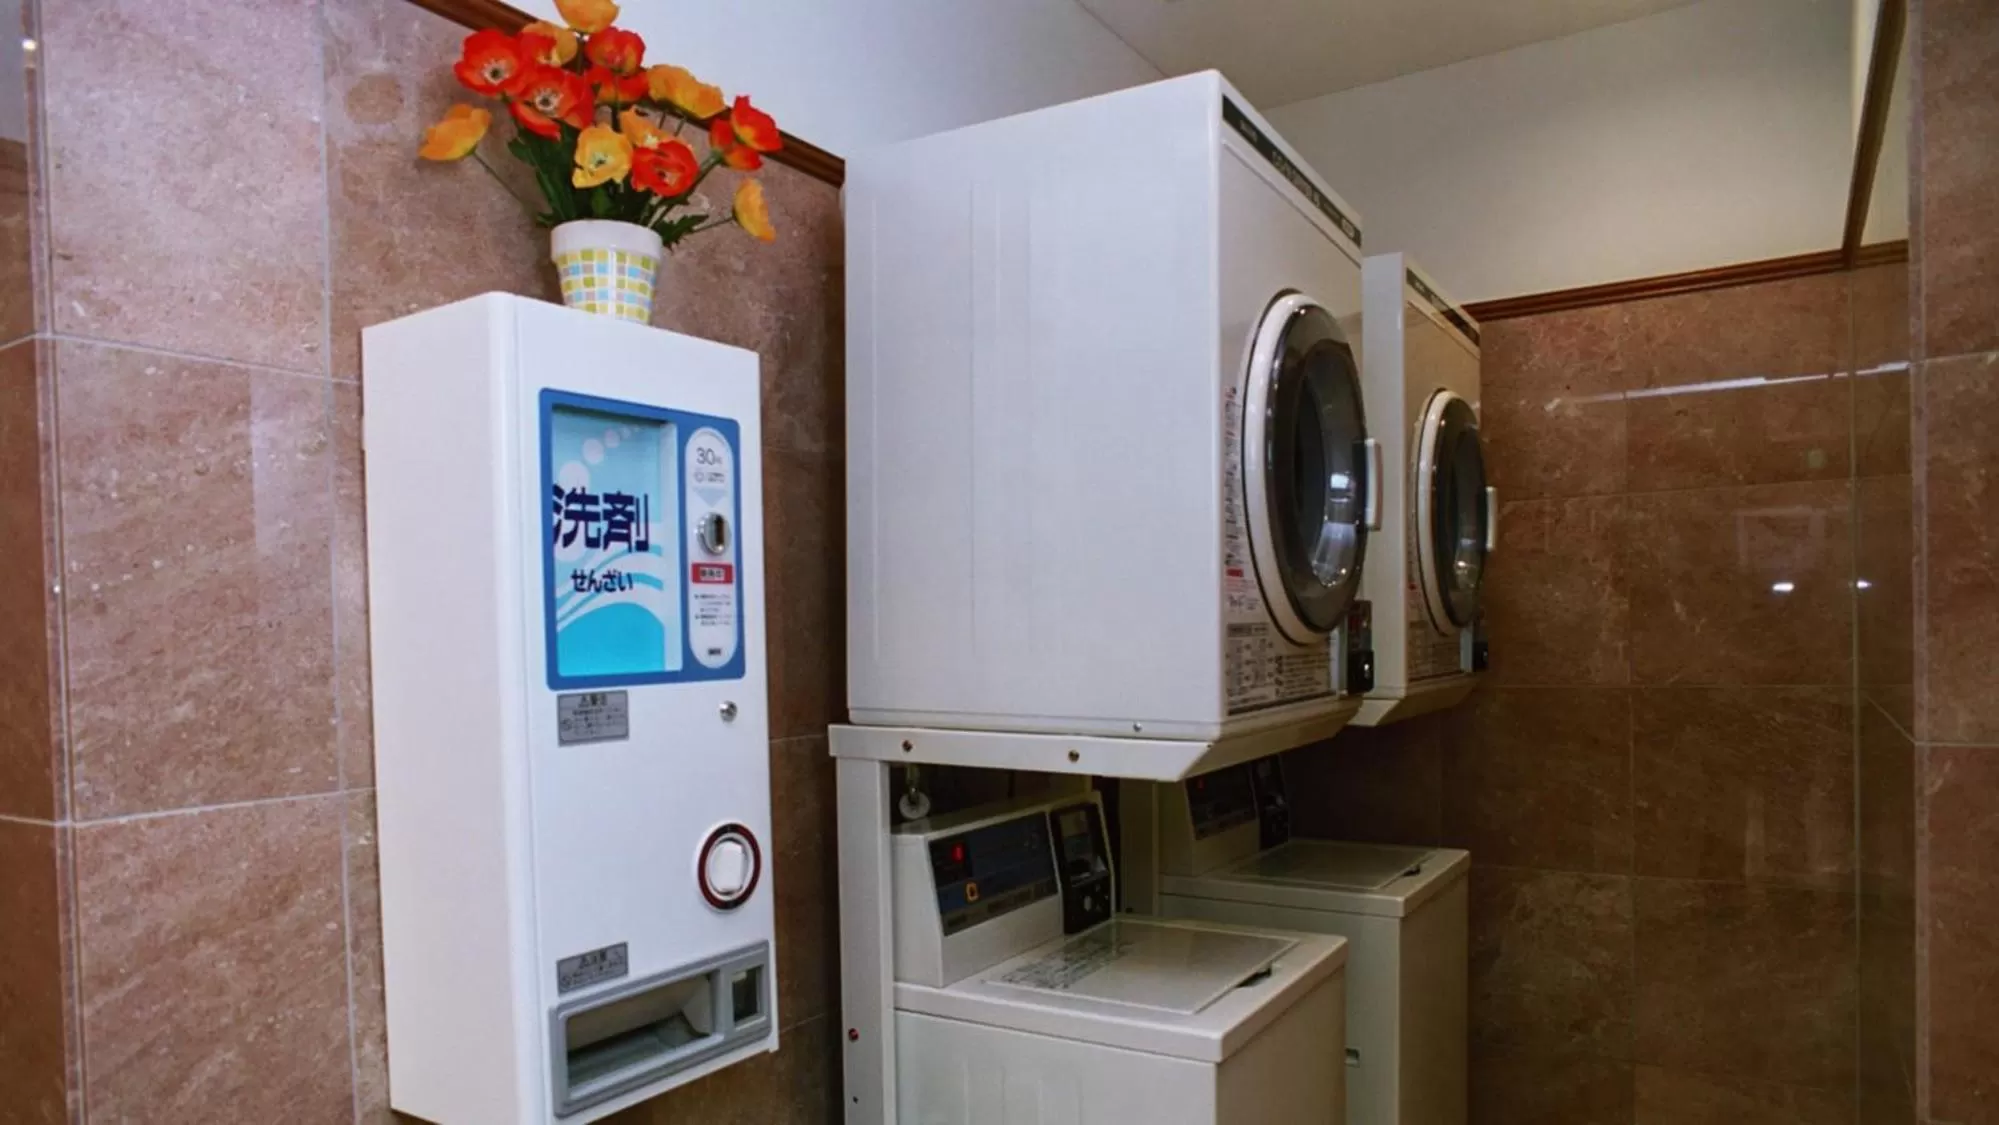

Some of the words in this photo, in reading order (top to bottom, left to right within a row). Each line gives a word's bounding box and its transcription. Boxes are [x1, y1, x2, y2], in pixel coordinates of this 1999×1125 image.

[553, 484, 649, 553] 洗剤
[571, 568, 633, 593] せんざい
